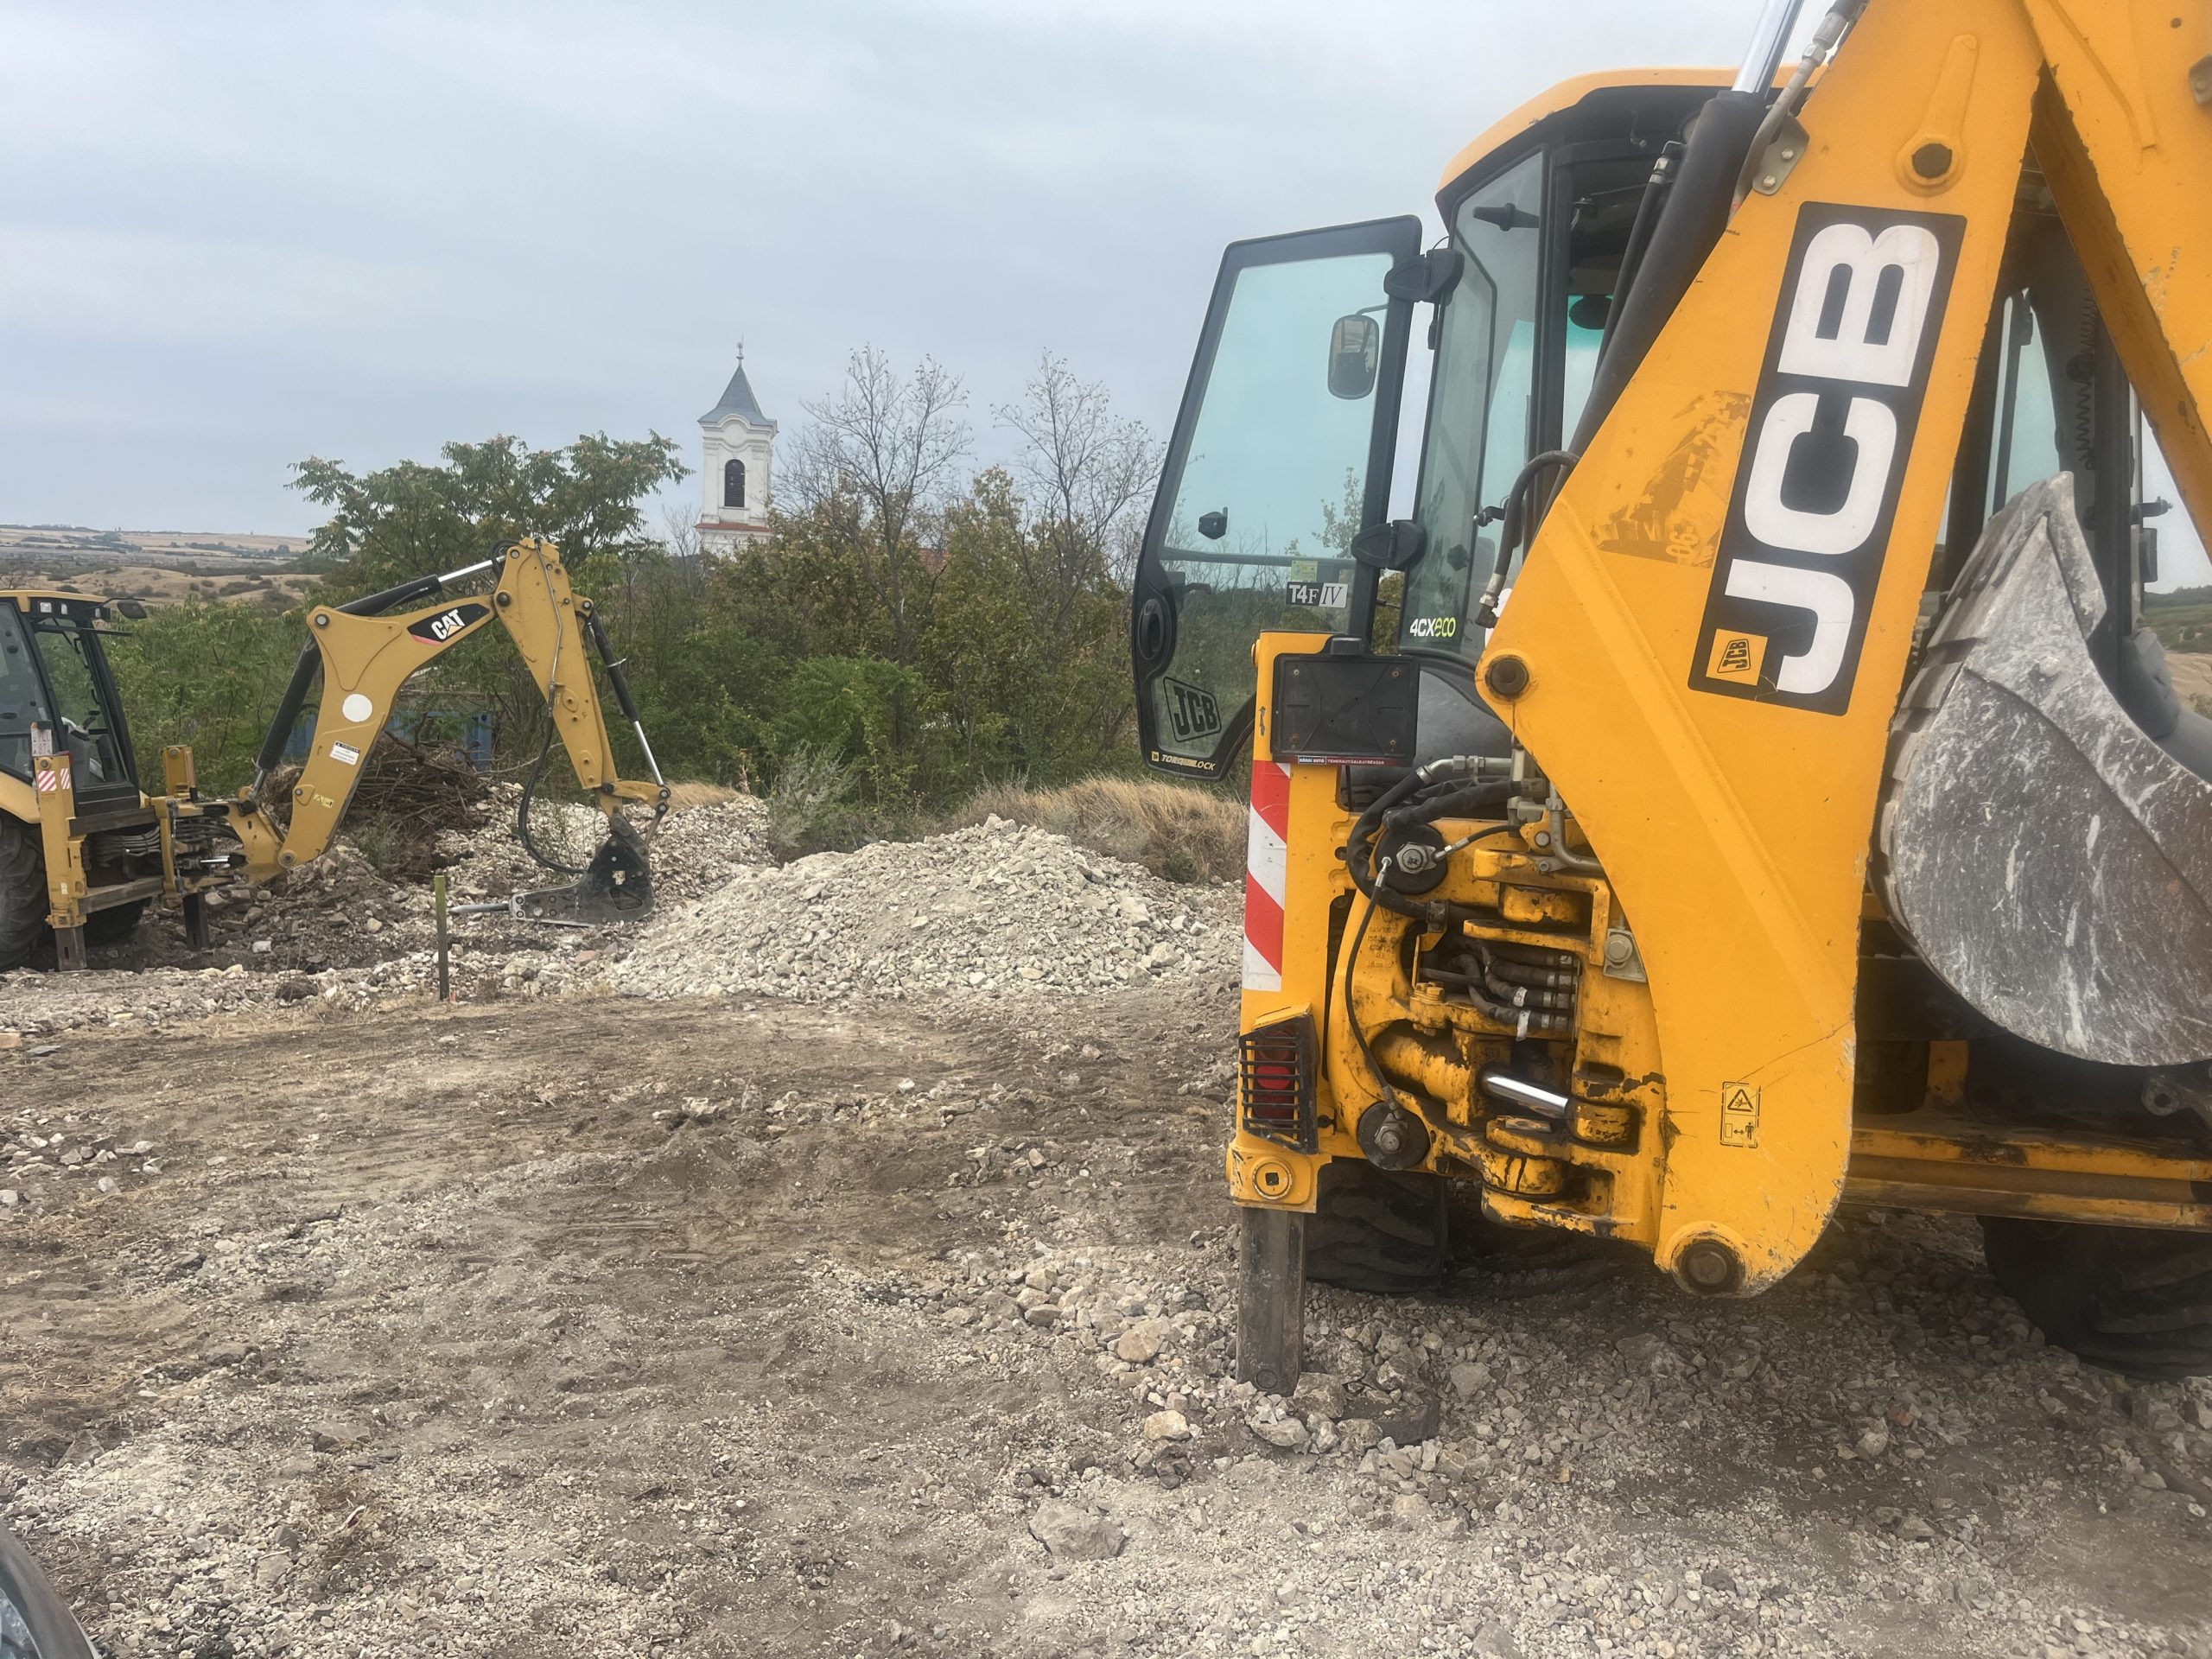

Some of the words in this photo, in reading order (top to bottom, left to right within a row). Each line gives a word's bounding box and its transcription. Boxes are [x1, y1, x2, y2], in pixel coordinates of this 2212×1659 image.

[1724, 223, 1940, 694] JCB
[431, 608, 466, 639] CAT
[1721, 641, 1748, 669] JCB
[1173, 685, 1217, 736] JCB
[1161, 753, 1217, 771] TORQLOCK
